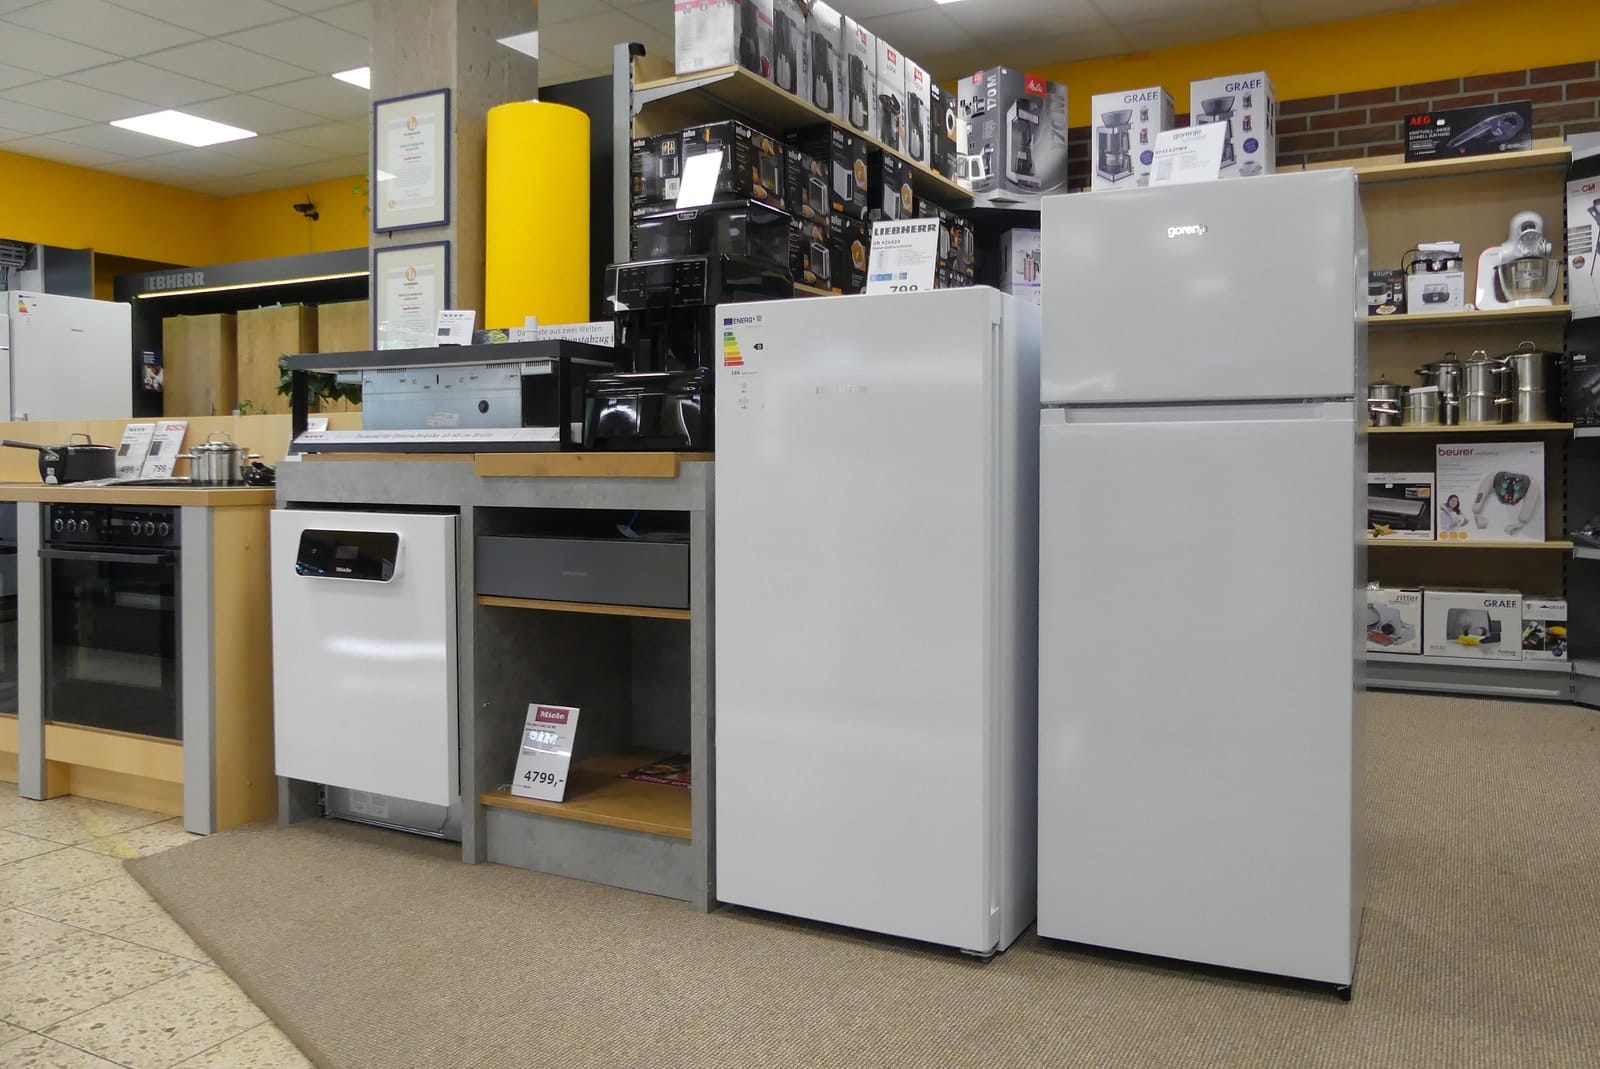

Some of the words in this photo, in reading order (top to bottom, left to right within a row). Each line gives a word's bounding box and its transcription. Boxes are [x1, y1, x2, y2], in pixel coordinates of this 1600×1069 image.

[874, 224, 937, 236] LIEBHERR
[1438, 447, 1474, 456] beurer
[1396, 594, 1419, 602] ritter
[540, 710, 566, 721] Miele
[524, 770, 564, 788] 4799,-
